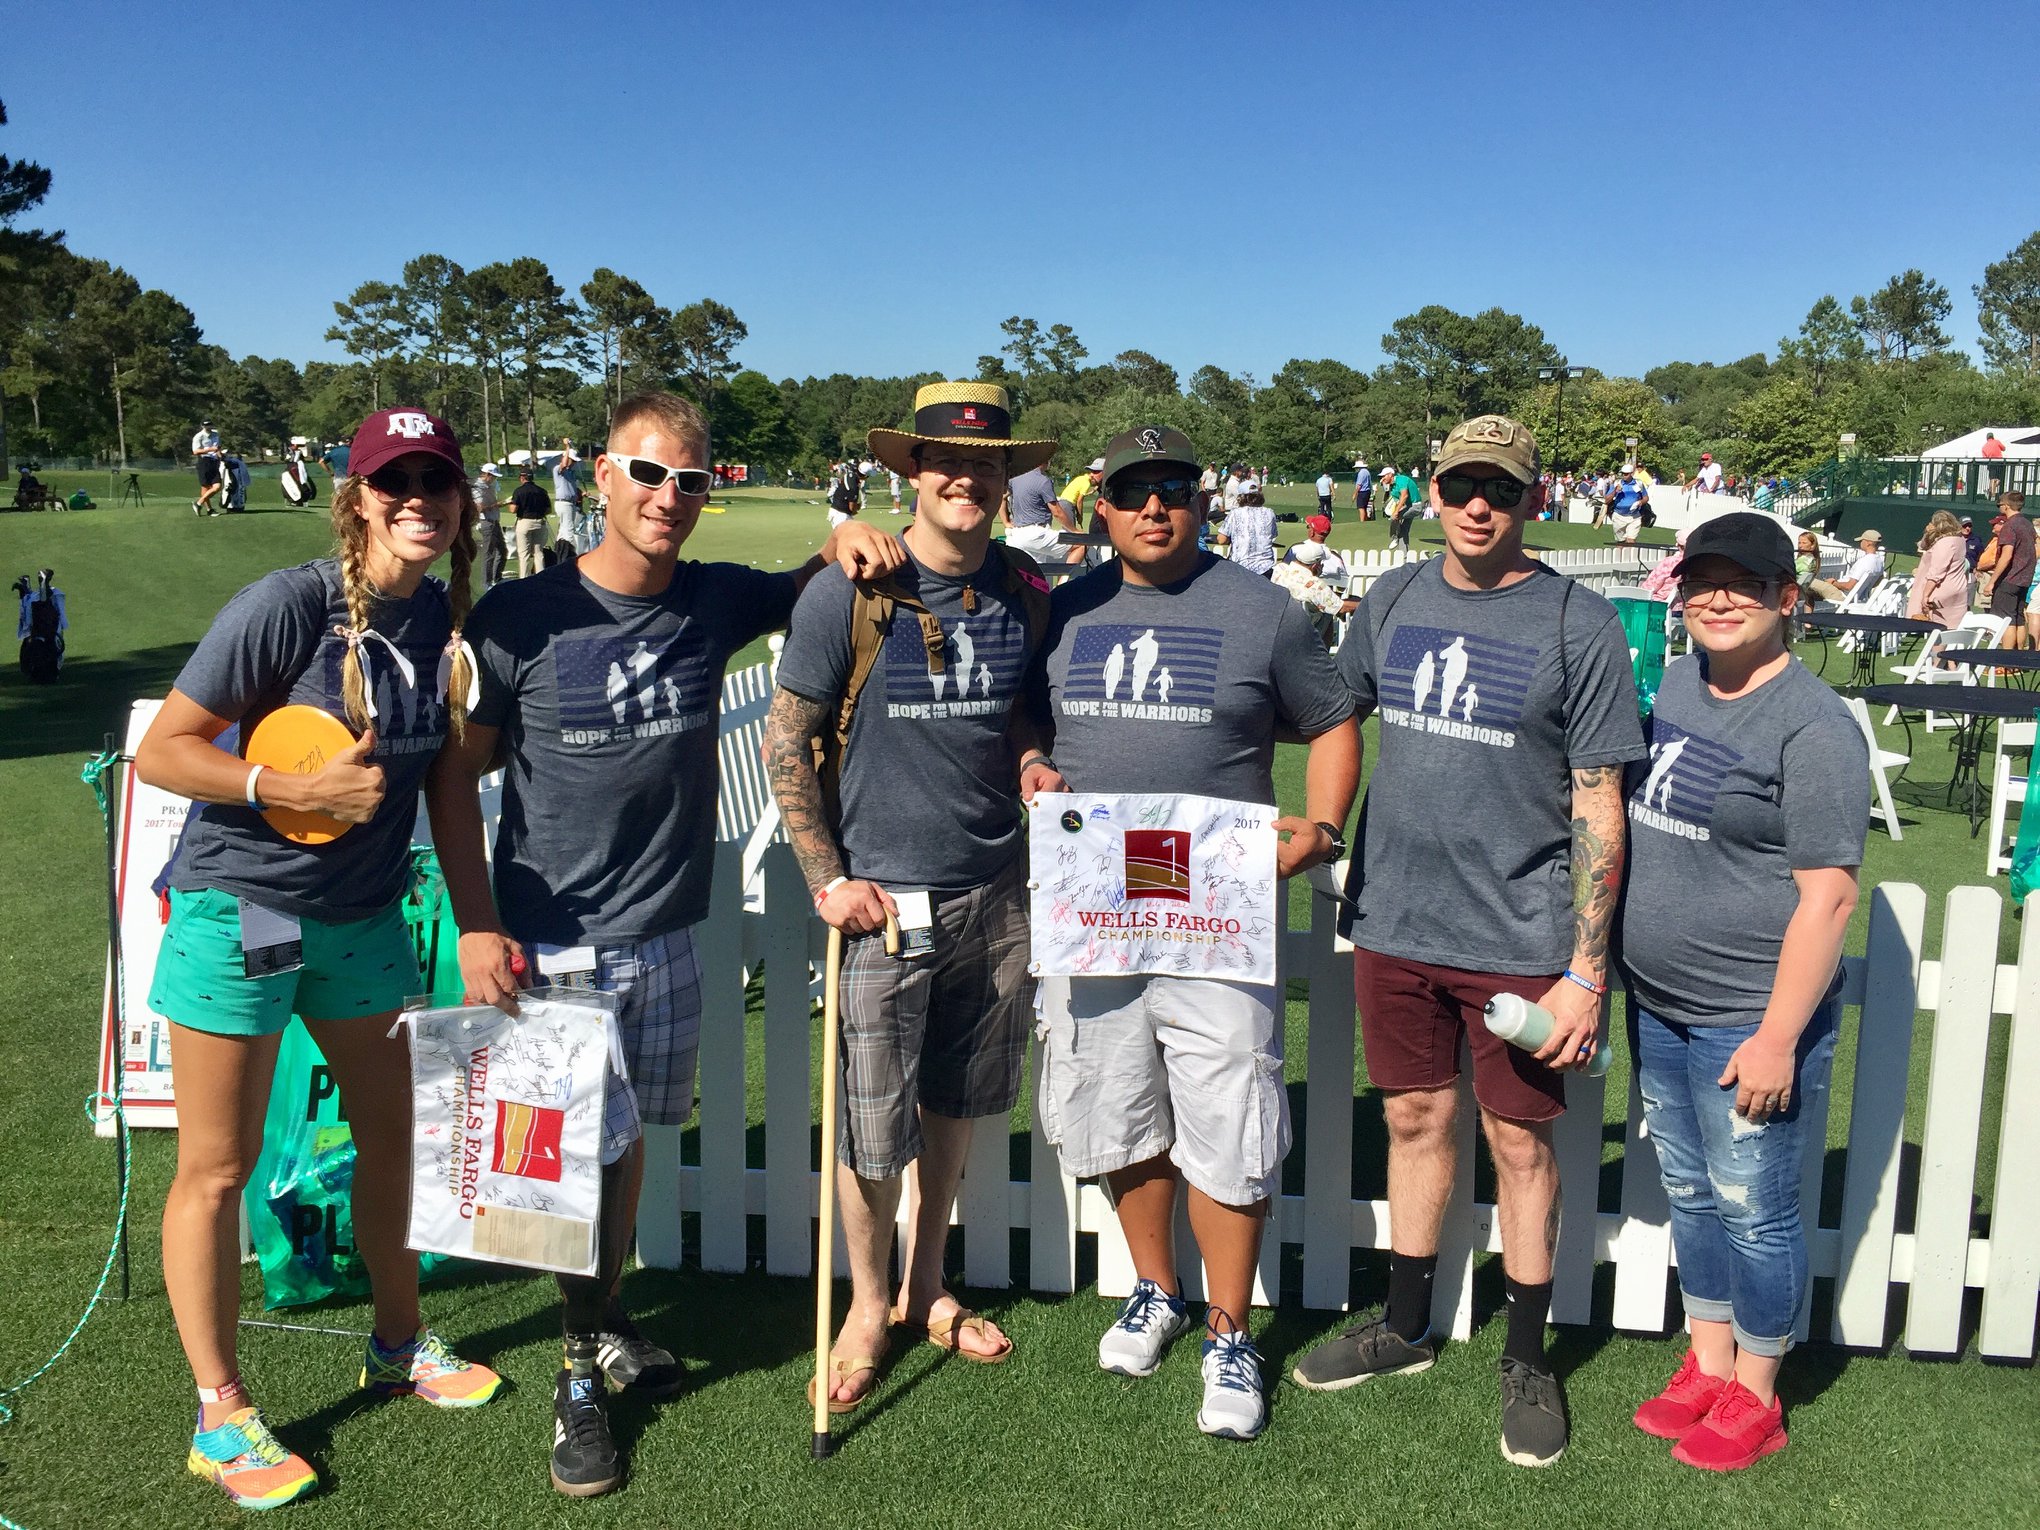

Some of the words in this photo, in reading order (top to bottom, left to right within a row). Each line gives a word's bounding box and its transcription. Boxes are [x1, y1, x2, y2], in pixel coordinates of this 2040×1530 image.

[888, 703, 931, 719] HOPE
[932, 703, 947, 711] FOR
[1061, 701, 1100, 716] HOPE
[1102, 702, 1119, 710] FOR
[1102, 709, 1119, 718] THE
[1121, 704, 1213, 723] WARRIORS
[1410, 721, 1425, 731] THE
[1411, 713, 1425, 723] FOR
[561, 728, 612, 745] HOPE
[614, 733, 632, 742] THE
[633, 711, 709, 739] WARRIORS
[1427, 716, 1516, 749] WARRIORS
[144, 819, 165, 828] 2017
[1234, 817, 1261, 830] 2017
[1633, 803, 1710, 842] WARRIORS
[1077, 911, 1159, 928] WELLS
[1165, 912, 1241, 934] FARGO
[1098, 930, 1222, 945] CHAMPIONSHIP
[466, 1046, 489, 1130] WELLS
[448, 1065, 467, 1196] CHAMPIONSHIP
[460, 1136, 482, 1220] FARGO
